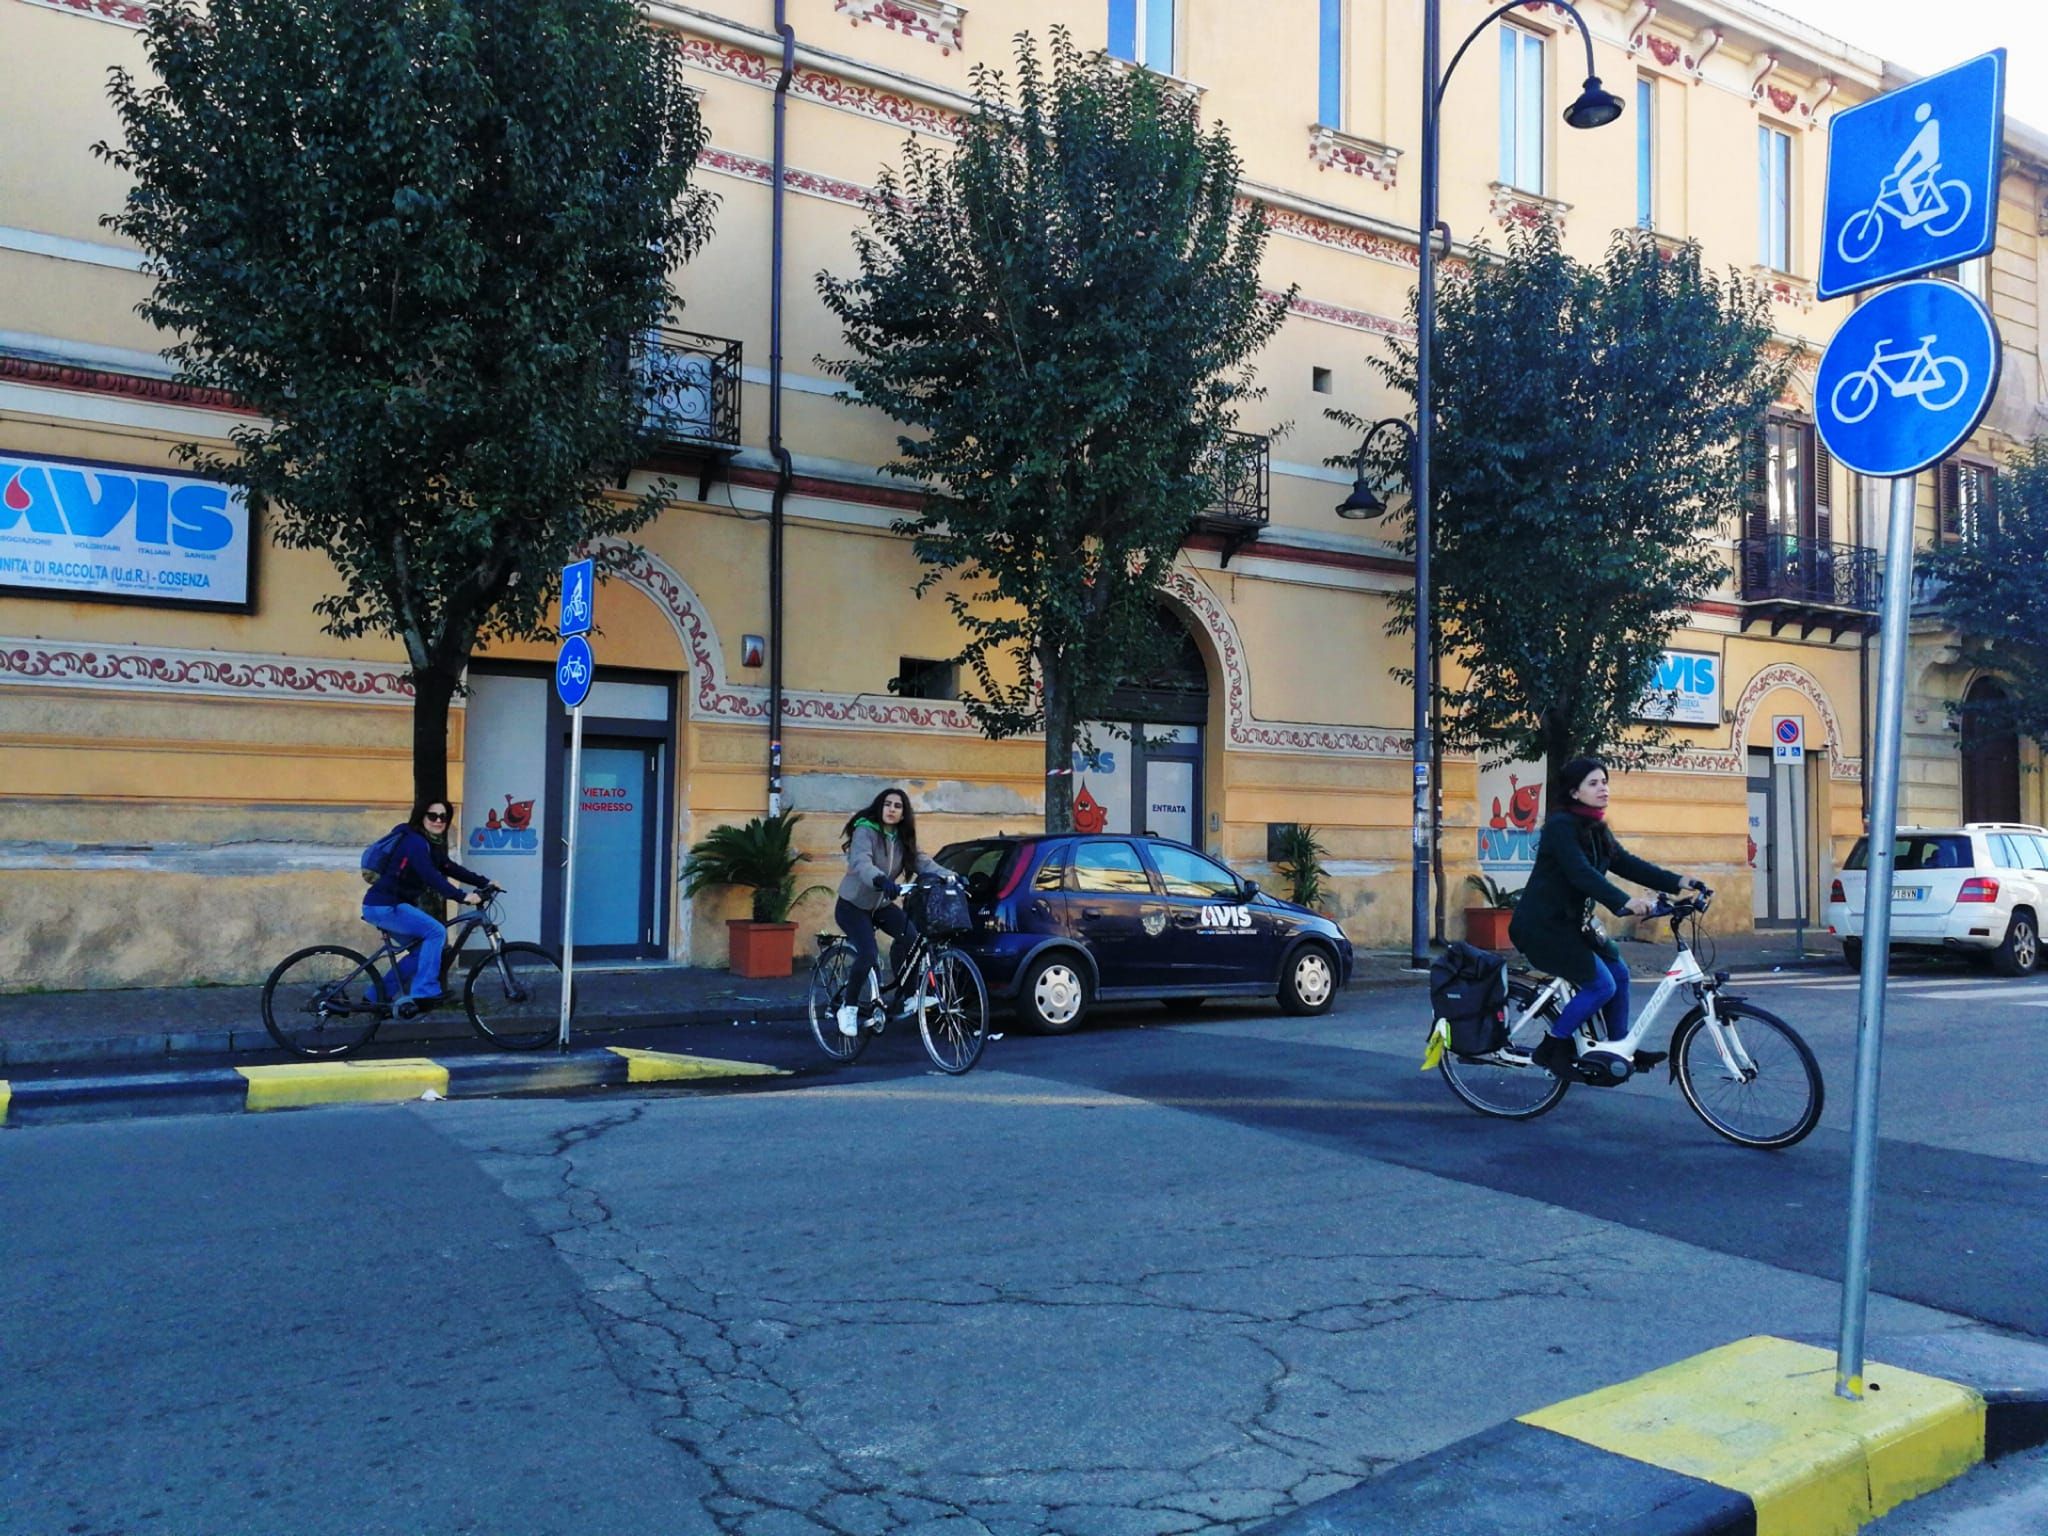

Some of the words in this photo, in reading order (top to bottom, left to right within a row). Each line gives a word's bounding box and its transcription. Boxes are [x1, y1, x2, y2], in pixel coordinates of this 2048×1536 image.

[34, 560, 45, 574] DI
[48, 561, 108, 580] RACCOLTA
[158, 571, 210, 588] COSENZA
[583, 787, 626, 798] VIETATO
[1152, 803, 1186, 813] ENTRATA
[469, 828, 539, 850] AVIS
[1201, 905, 1252, 928] AVIS
